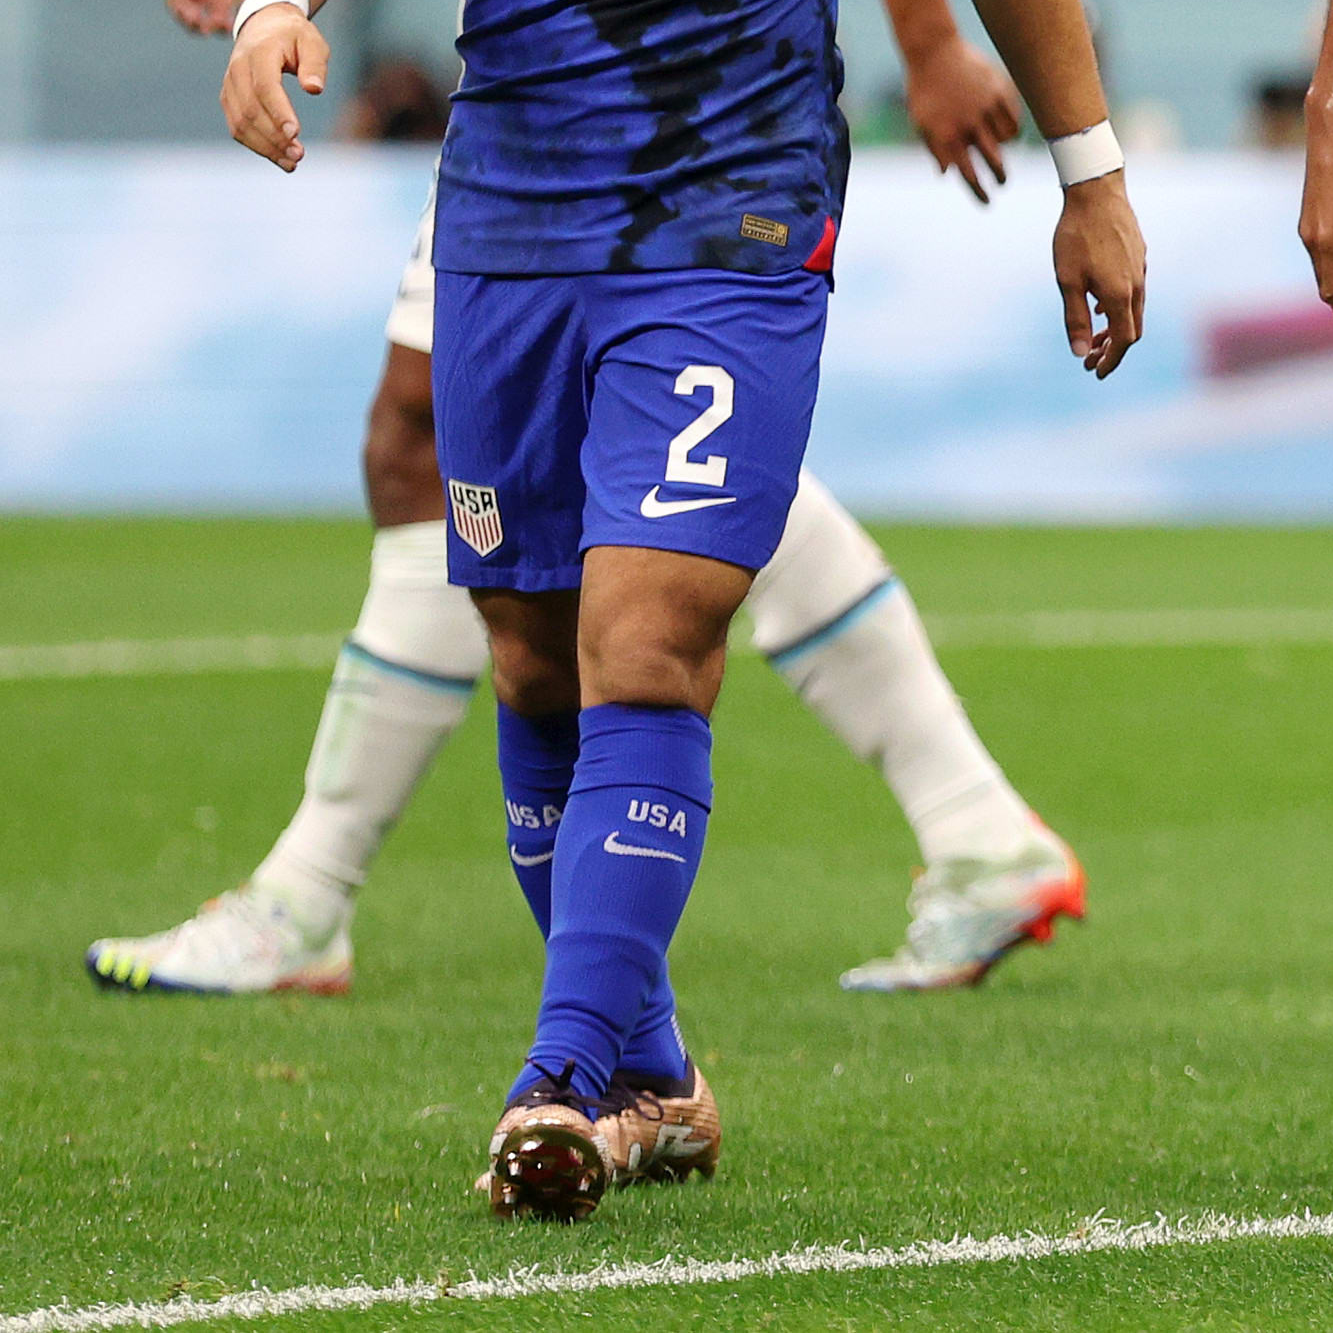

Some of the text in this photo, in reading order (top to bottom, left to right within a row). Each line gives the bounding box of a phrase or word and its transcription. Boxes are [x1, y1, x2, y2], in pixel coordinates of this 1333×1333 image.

[665, 364, 735, 488] 2
[452, 485, 494, 514] USA
[506, 799, 562, 829] USA
[627, 799, 687, 838] USA
